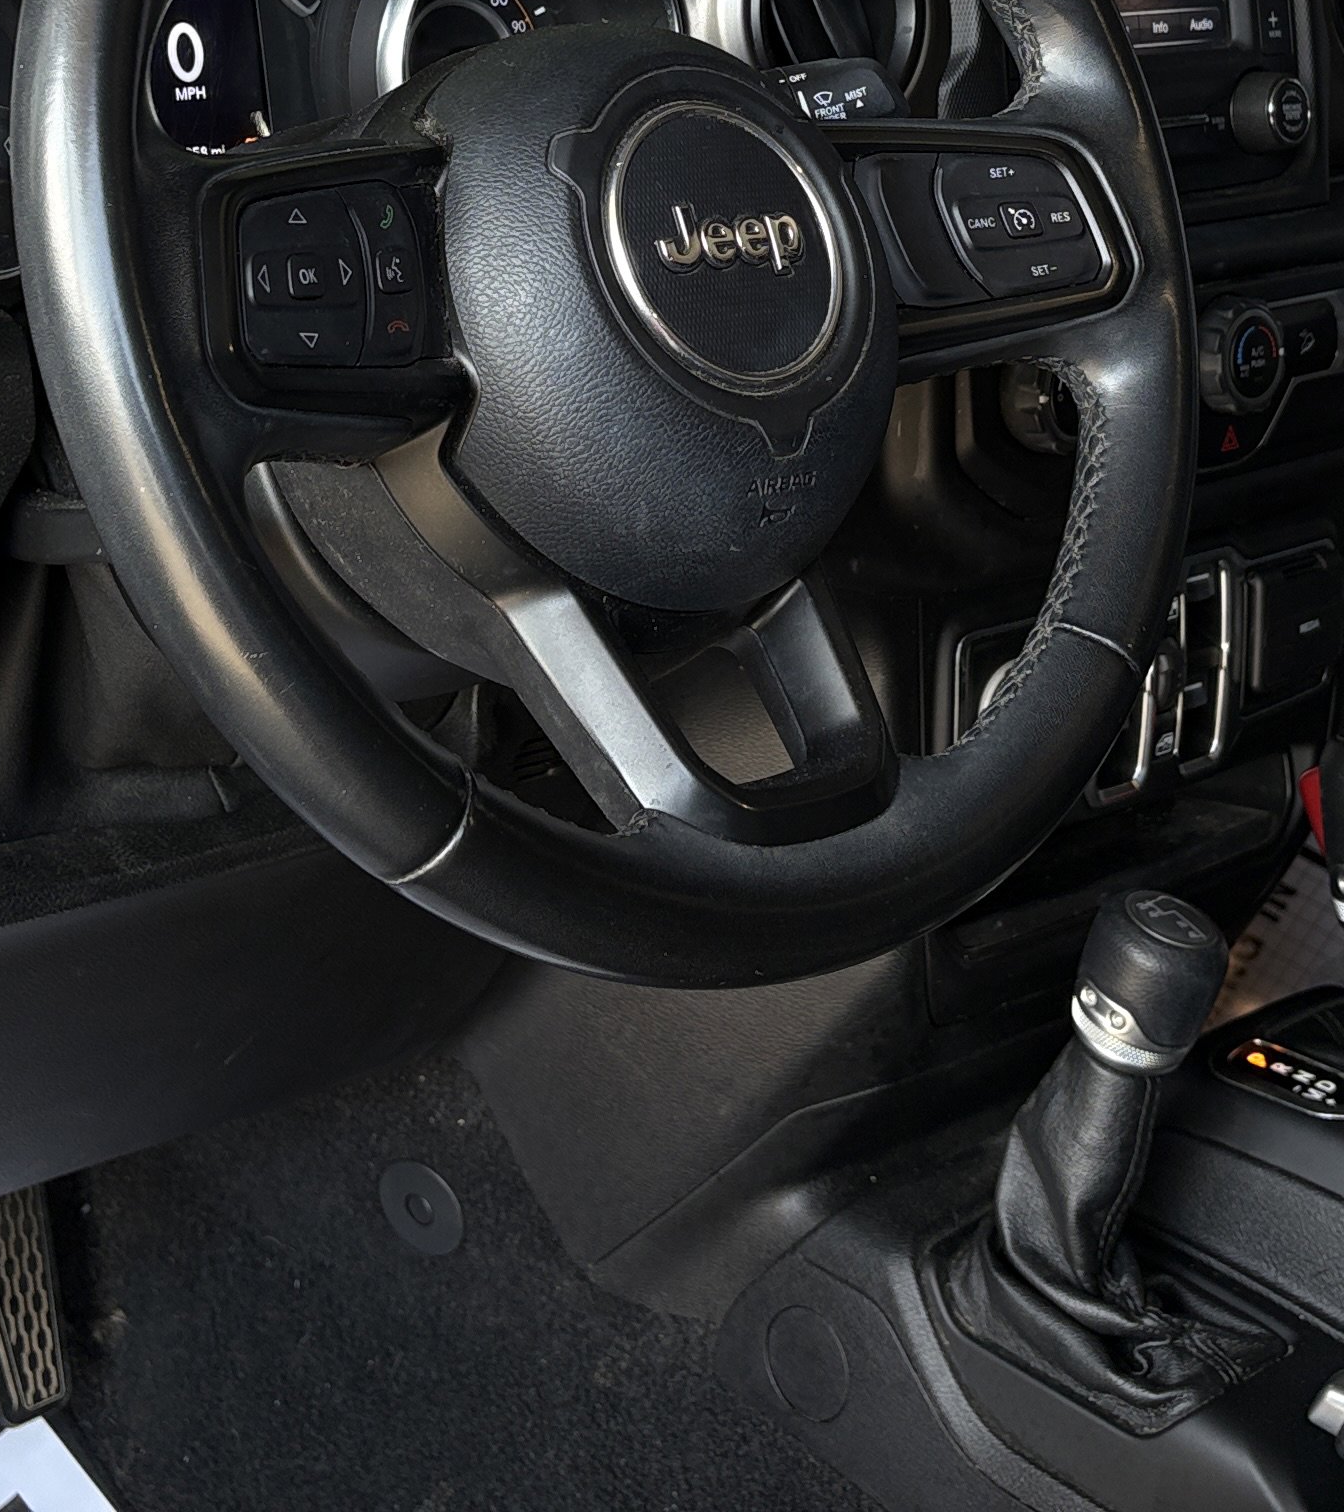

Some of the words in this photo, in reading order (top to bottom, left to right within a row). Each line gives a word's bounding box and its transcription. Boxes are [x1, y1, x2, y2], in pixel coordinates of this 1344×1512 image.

[511, 19, 527, 34] 90
[1152, 20, 1169, 34] Info
[1189, 18, 1214, 32] Audio
[167, 21, 205, 83] 0
[789, 72, 807, 83] OFF
[175, 86, 206, 102] MPH
[844, 86, 867, 102] MIST
[814, 102, 845, 119] FRONT
[967, 216, 996, 230] CANC
[1050, 210, 1071, 224] RES
[656, 202, 804, 275] Jeep
[297, 268, 319, 288] OK
[745, 472, 817, 497] AIRBAG
[1269, 1062, 1294, 1076] R
[1291, 1069, 1317, 1085] N
[1314, 1079, 1337, 1094] D
